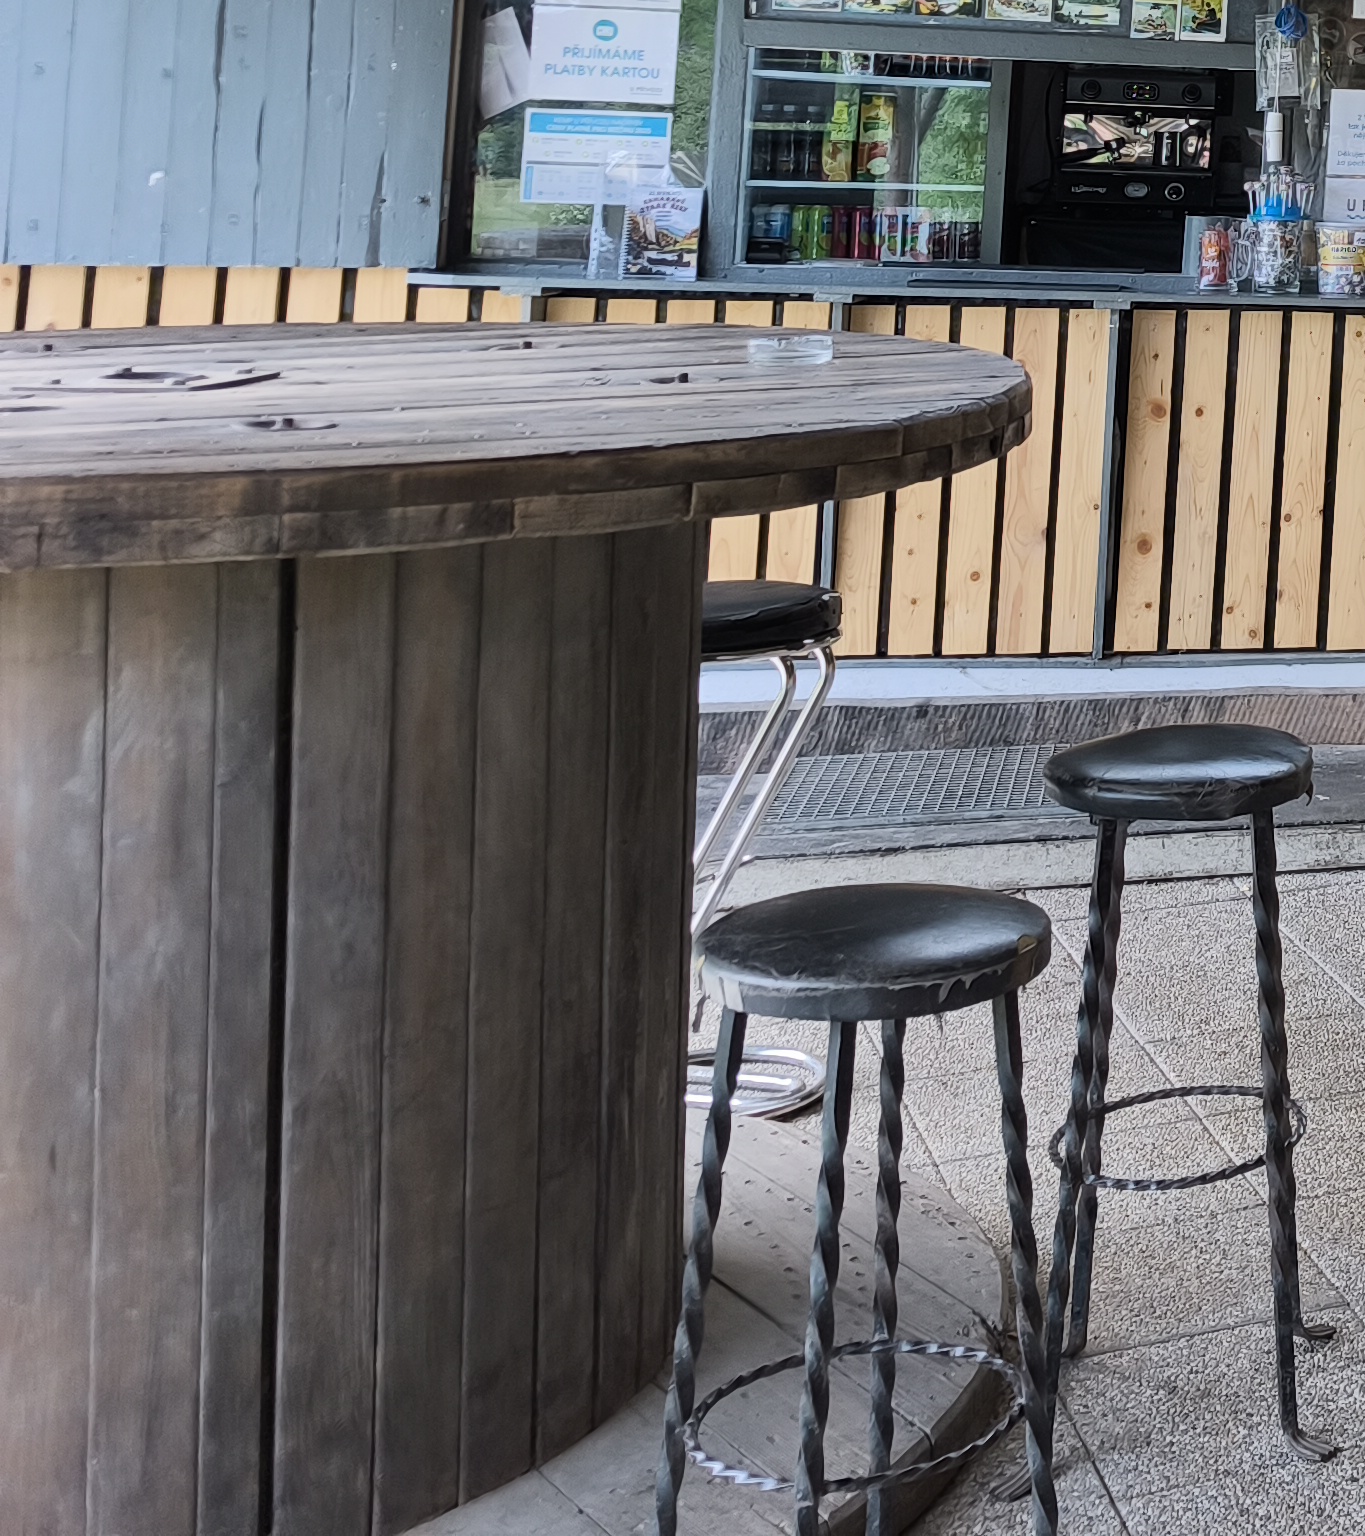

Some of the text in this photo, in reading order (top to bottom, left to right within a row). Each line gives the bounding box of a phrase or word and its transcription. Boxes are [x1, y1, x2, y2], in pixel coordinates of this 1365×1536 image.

[562, 45, 645, 62] PŘIJÍMÁME
[544, 64, 659, 79] PLATBY KARTOU
[1347, 199, 1356, 211] U
